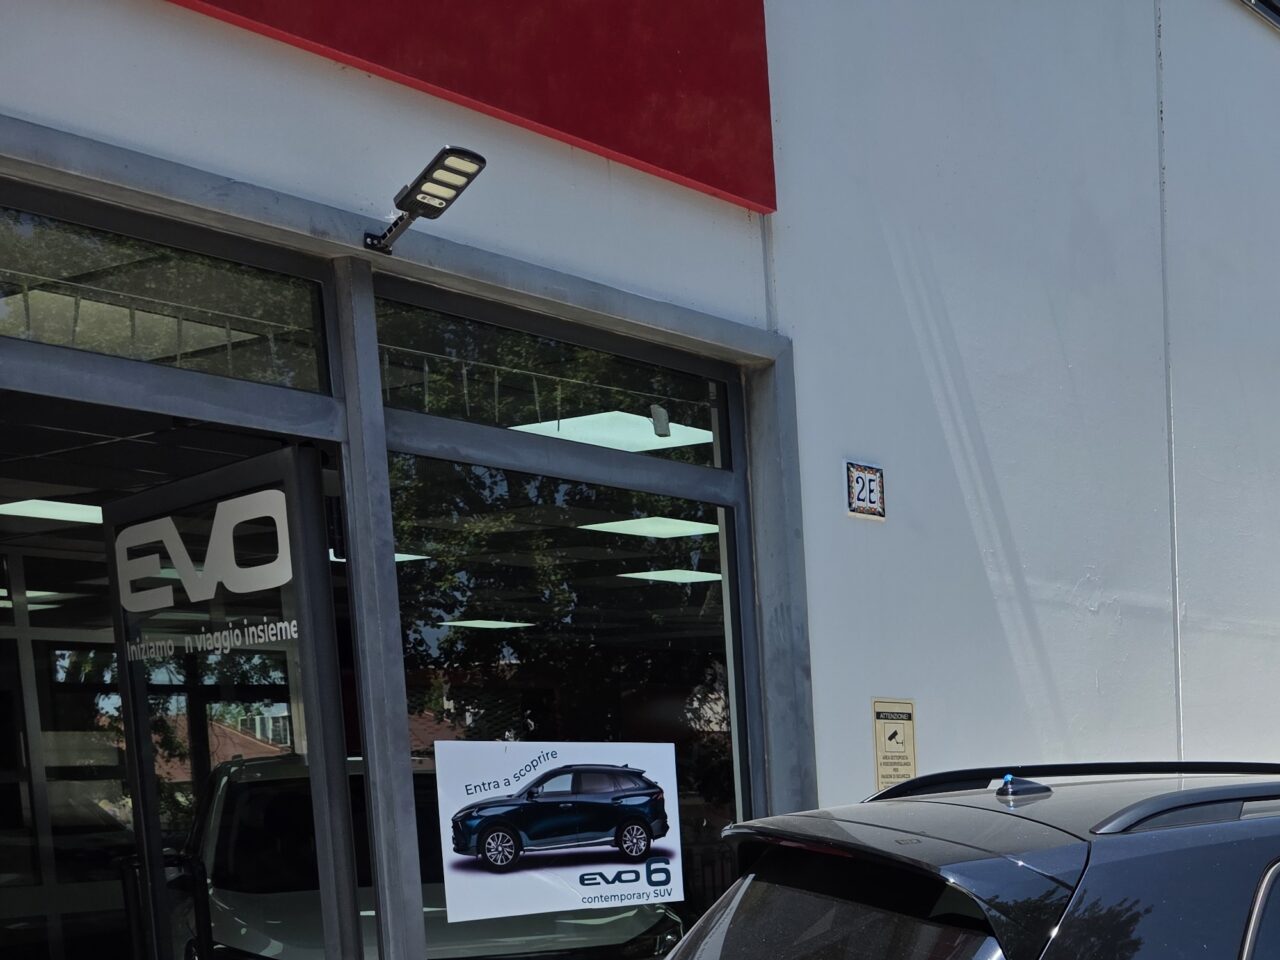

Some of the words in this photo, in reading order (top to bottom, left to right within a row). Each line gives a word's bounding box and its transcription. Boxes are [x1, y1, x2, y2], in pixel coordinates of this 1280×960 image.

[855, 475, 877, 504] 2E
[115, 489, 293, 613] EVO
[195, 622, 242, 655] viaggio
[244, 616, 299, 646] insieme
[464, 780, 500, 796] Entra
[503, 776, 511, 788] a
[513, 749, 558, 782] scoprire
[579, 869, 640, 887] EVO
[645, 858, 671, 887] 6
[581, 890, 651, 904] contemporary
[653, 887, 673, 898] SUV
